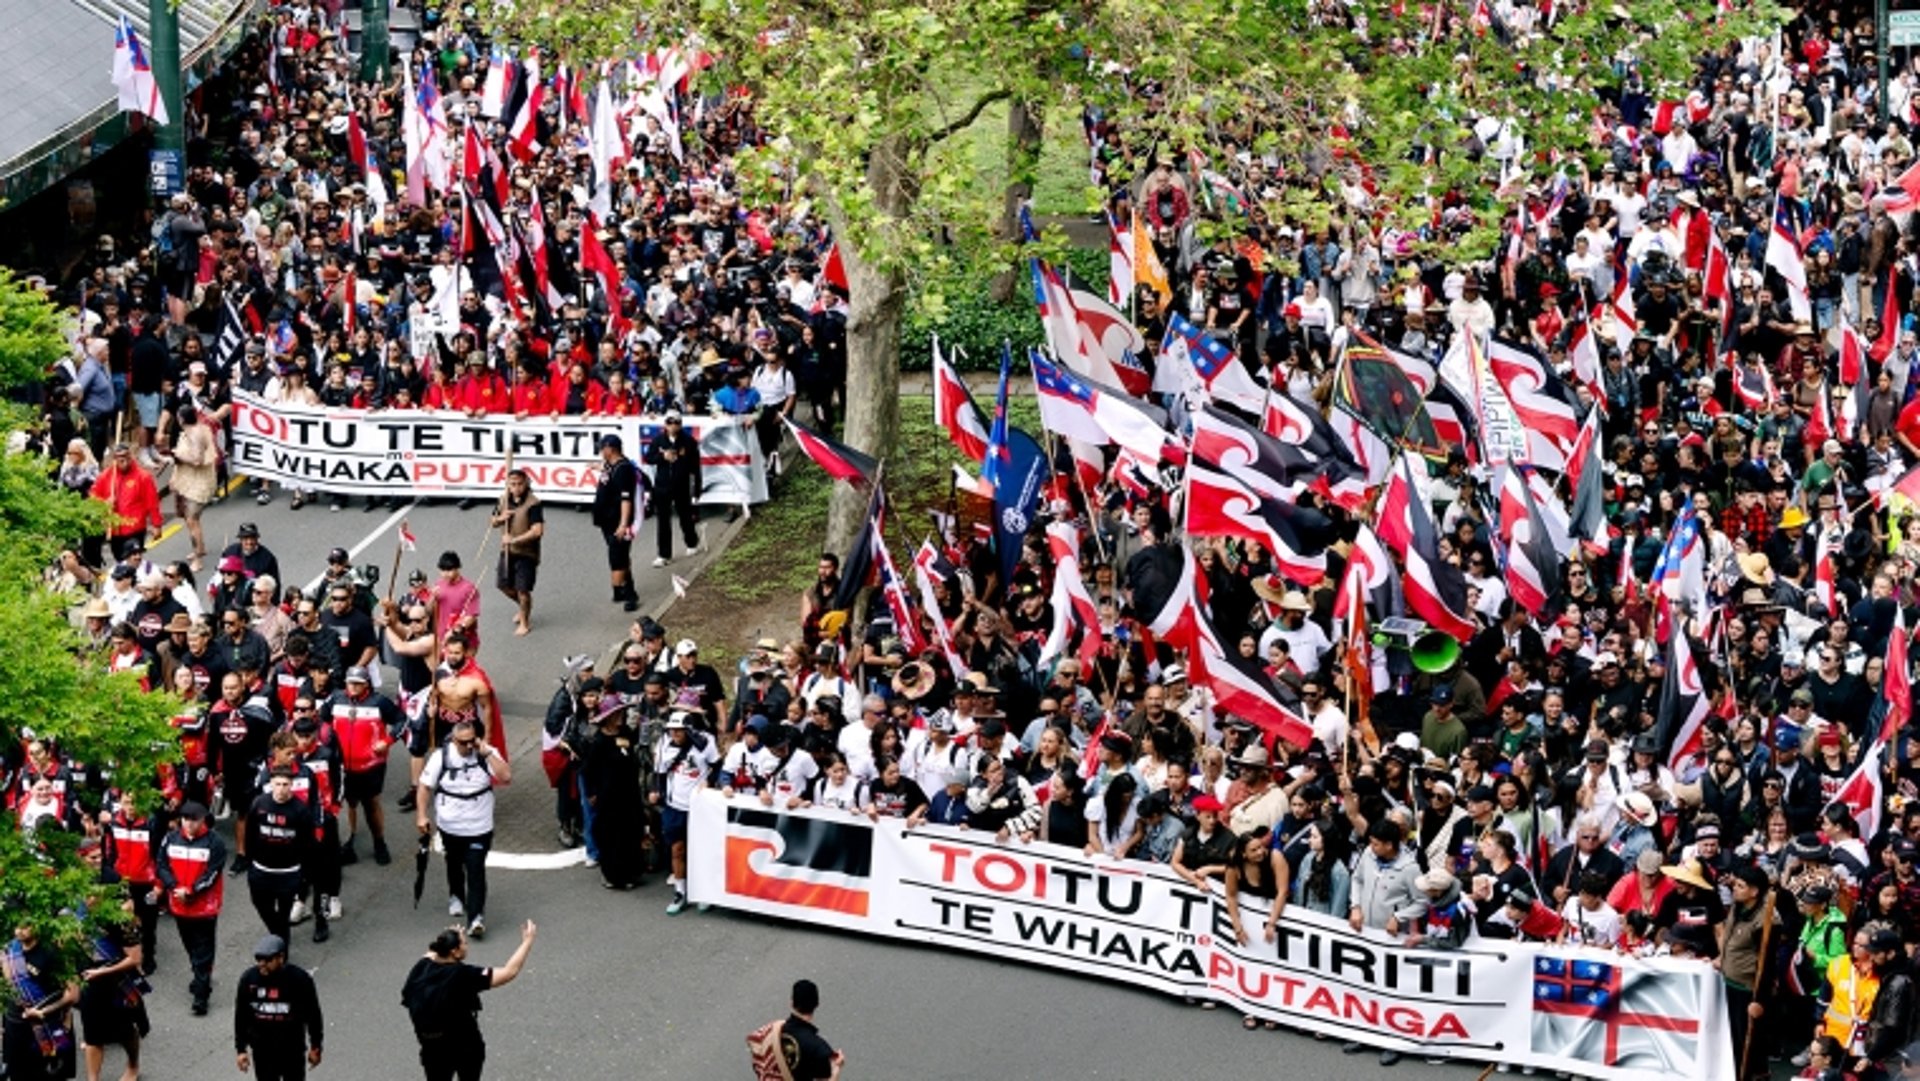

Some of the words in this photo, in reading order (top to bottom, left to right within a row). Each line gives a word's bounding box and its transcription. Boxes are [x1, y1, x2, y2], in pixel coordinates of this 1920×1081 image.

[378, 424, 444, 450] TE
[462, 426, 601, 457] TIRITI
[932, 897, 994, 934] TE
[1013, 911, 1470, 1039] WHAKAPUTANGA
[1170, 889, 1246, 947] TE
[1263, 921, 1471, 996] TIRITI
[1177, 932, 1211, 946] me
